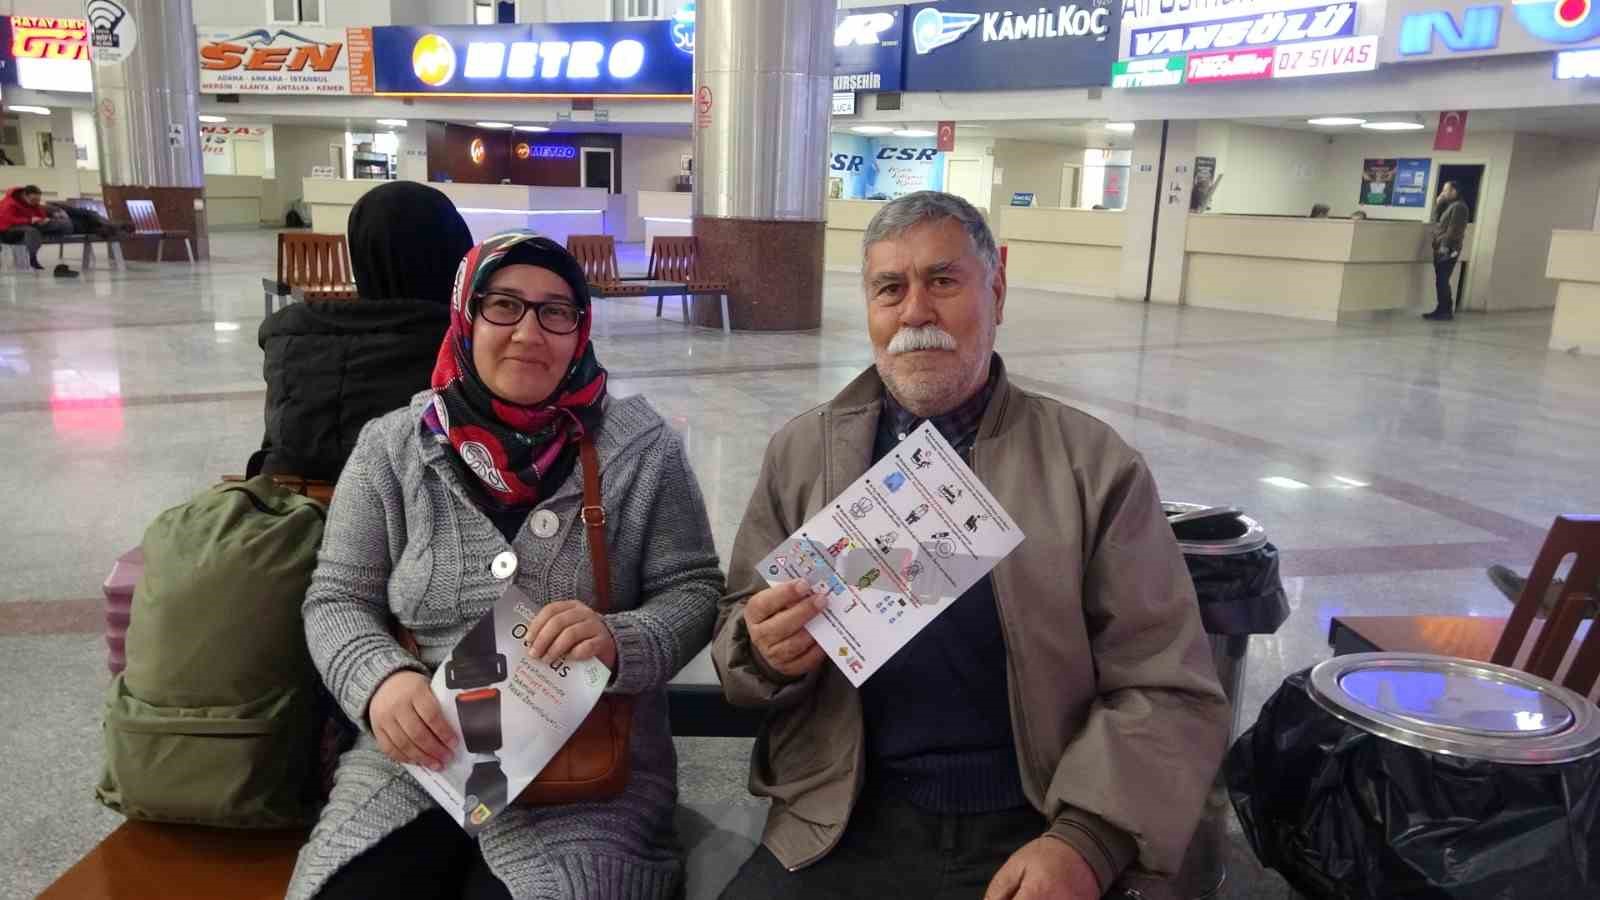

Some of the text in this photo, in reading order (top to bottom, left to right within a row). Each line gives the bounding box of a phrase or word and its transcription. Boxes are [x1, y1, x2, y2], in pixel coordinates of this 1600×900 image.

[200, 43, 343, 72] SEN
[463, 39, 645, 78] METRO
[876, 147, 938, 160] CSR
